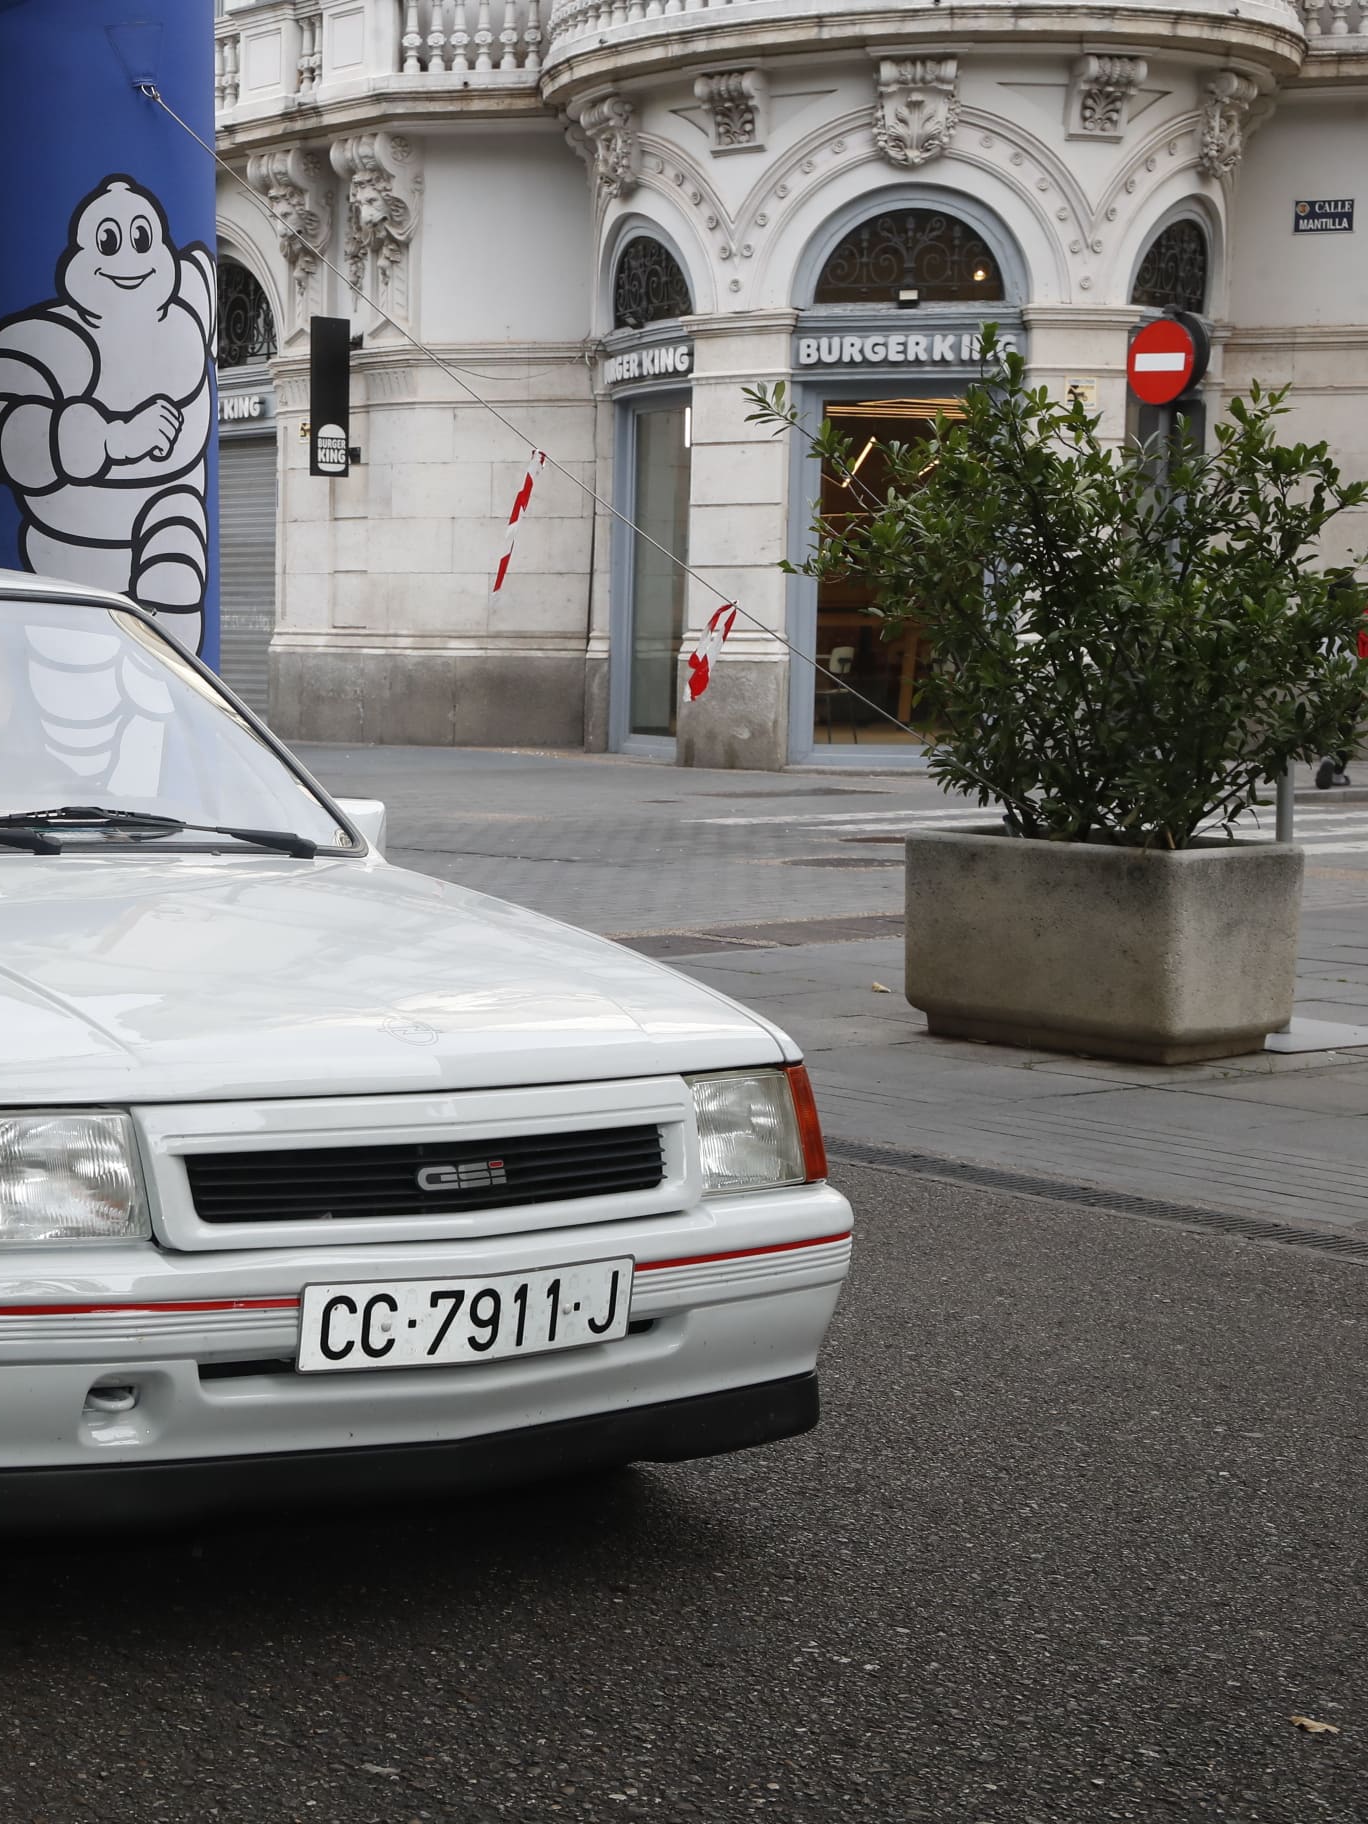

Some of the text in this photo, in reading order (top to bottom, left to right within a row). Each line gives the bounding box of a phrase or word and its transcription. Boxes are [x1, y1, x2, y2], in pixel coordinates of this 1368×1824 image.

[1315, 201, 1352, 213] CALLE
[1300, 218, 1349, 229] MANTILLA
[799, 334, 929, 365] BURGER
[641, 344, 690, 377] KING
[223, 395, 261, 420] KING
[317, 438, 346, 449] BURGER
[317, 449, 346, 463] KING
